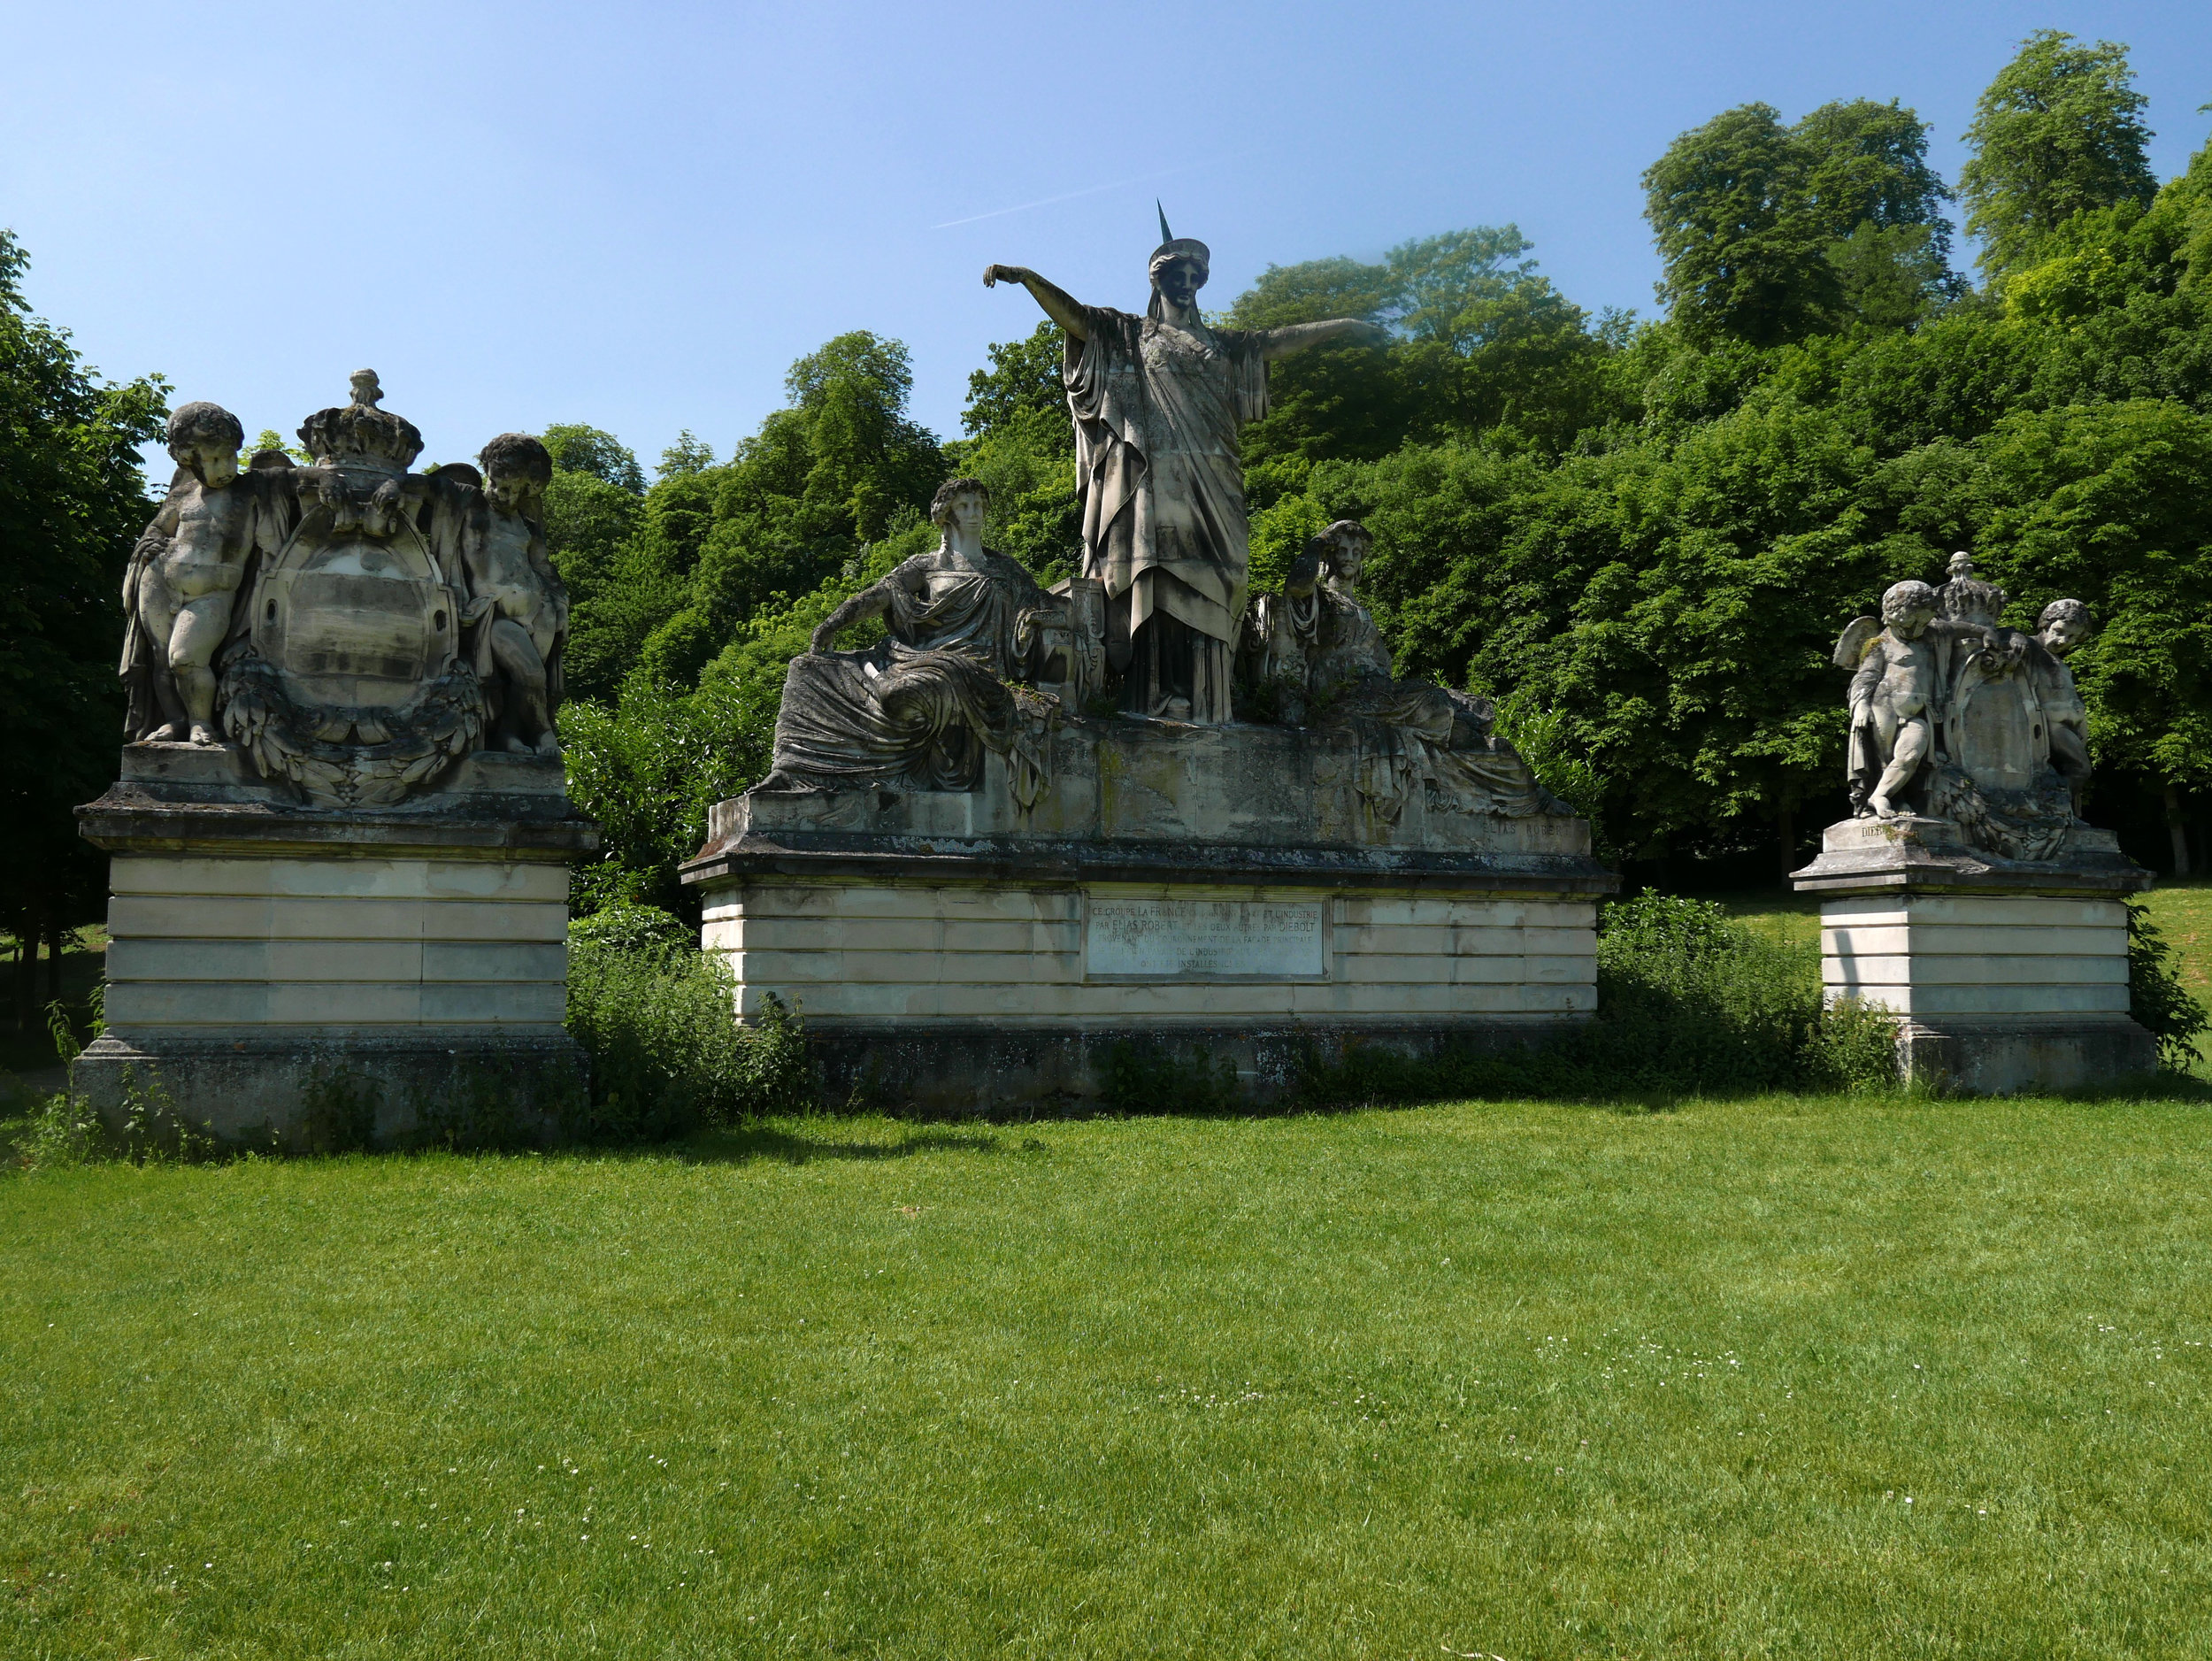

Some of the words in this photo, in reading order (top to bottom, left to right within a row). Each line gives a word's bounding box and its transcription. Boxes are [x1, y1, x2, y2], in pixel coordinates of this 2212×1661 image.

[1482, 822, 1517, 834] ELIAS
[1526, 824, 1570, 836] ROBERT
[1862, 826, 1885, 837] DIEB
[1092, 907, 1103, 916] CE
[1105, 907, 1135, 917] GROUPE
[1138, 905, 1148, 917] LA
[1095, 921, 1110, 930] PAR
[1112, 919, 1138, 931] ELIAS
[1141, 919, 1179, 931] ROBERT
[1210, 923, 1231, 932] DEUX
[1279, 921, 1316, 932] DIEBOLT
